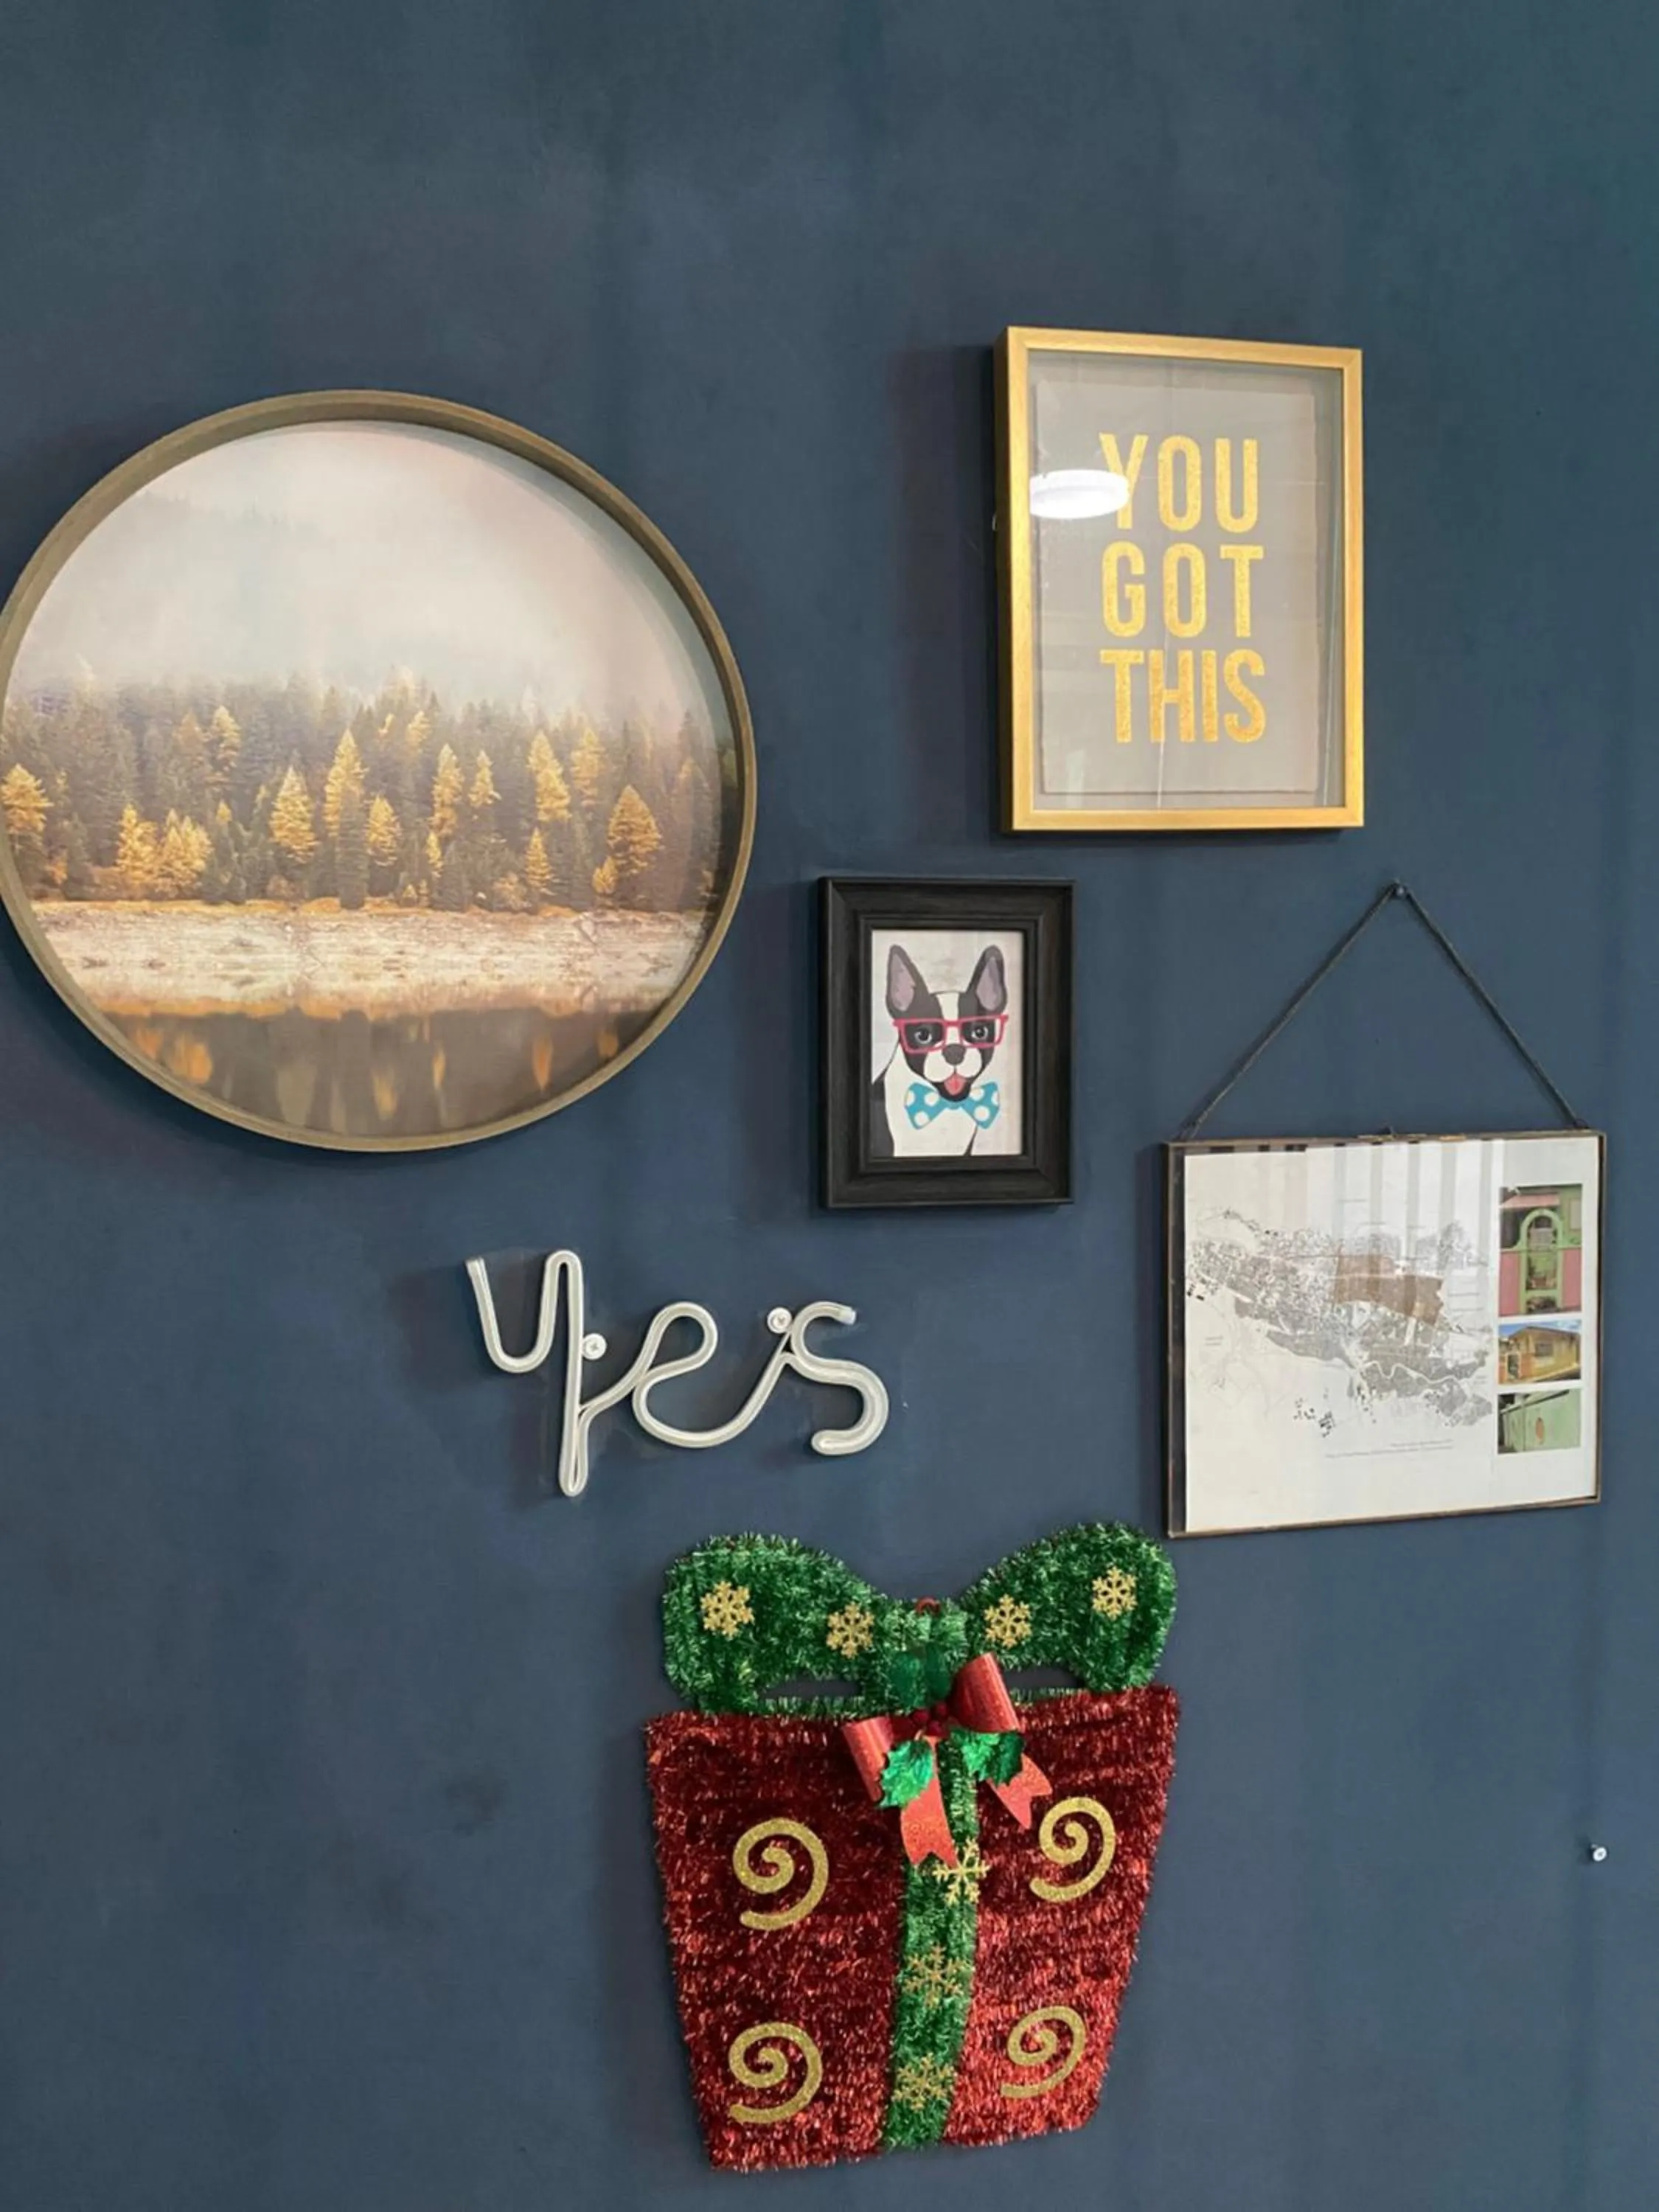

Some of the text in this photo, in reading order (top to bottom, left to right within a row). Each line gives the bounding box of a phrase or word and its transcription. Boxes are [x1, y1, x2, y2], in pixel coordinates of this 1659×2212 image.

[1099, 433, 1259, 533] YOU
[1102, 541, 1264, 638] GOT
[1100, 649, 1267, 744] THIS
